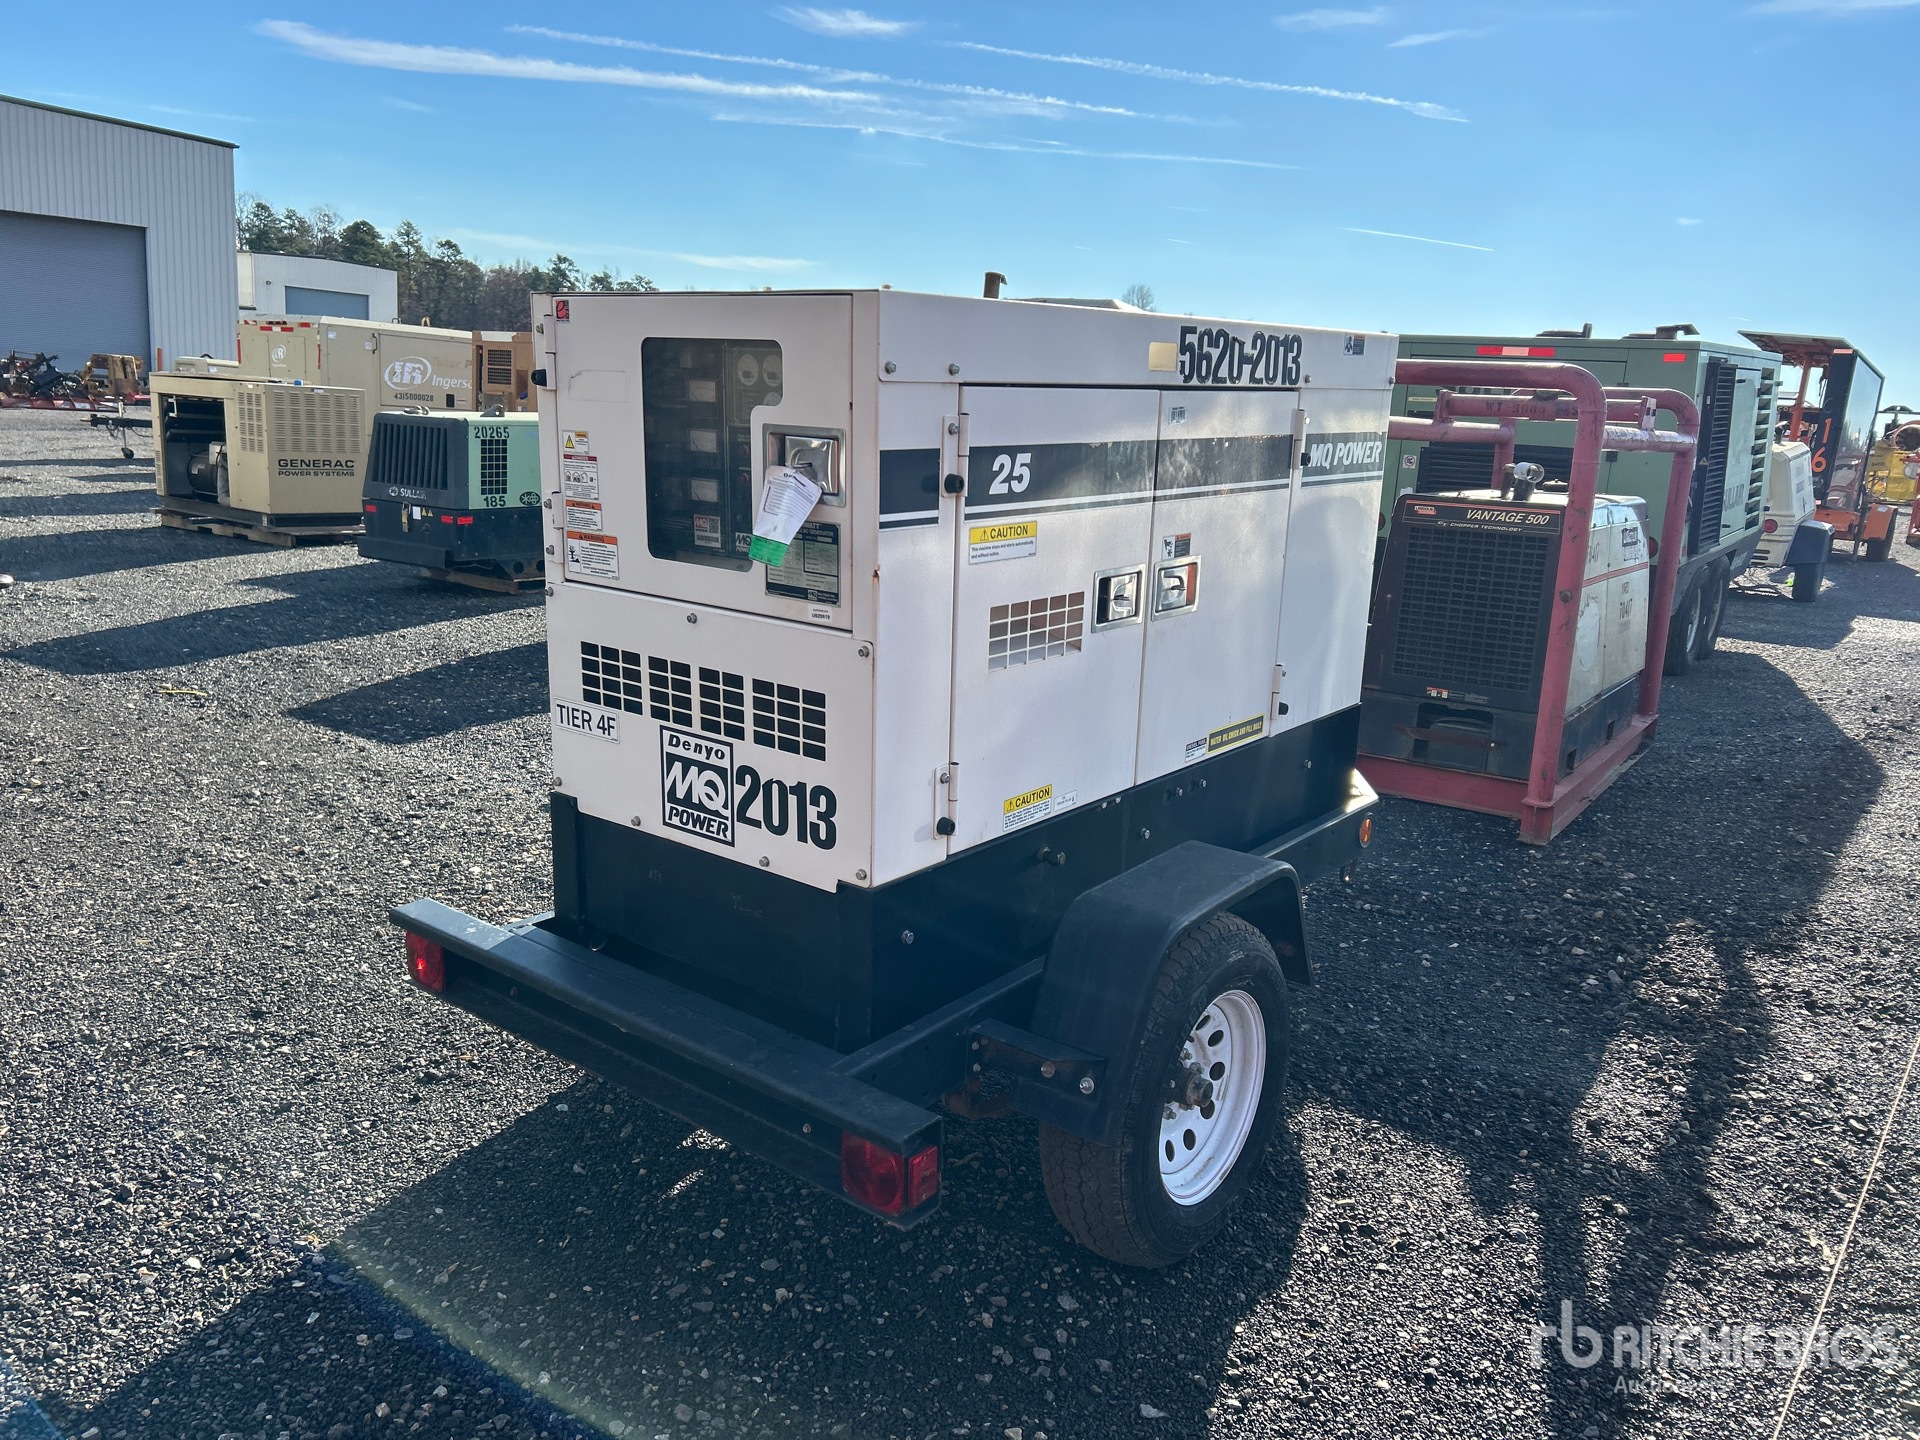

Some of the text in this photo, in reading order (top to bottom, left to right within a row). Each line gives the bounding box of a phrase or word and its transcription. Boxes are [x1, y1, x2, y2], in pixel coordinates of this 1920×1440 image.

[1179, 325, 1303, 386] 5620-2013
[474, 426, 510, 439] 20265
[278, 459, 355, 468] GENERAC
[1333, 441, 1383, 466] POWER
[989, 453, 1032, 495] 25
[483, 496, 507, 507] 185
[1466, 509, 1550, 525] VANTAGE 500
[1481, 524, 1523, 532] TECHNOLOGY
[990, 525, 1028, 540] CAUTION
[556, 703, 616, 736] TIER 4F
[668, 733, 726, 760] Denyo
[667, 761, 729, 818] MQ
[1015, 787, 1050, 808] CAUTION
[735, 764, 838, 850] 2013
[668, 805, 729, 839] POWER
